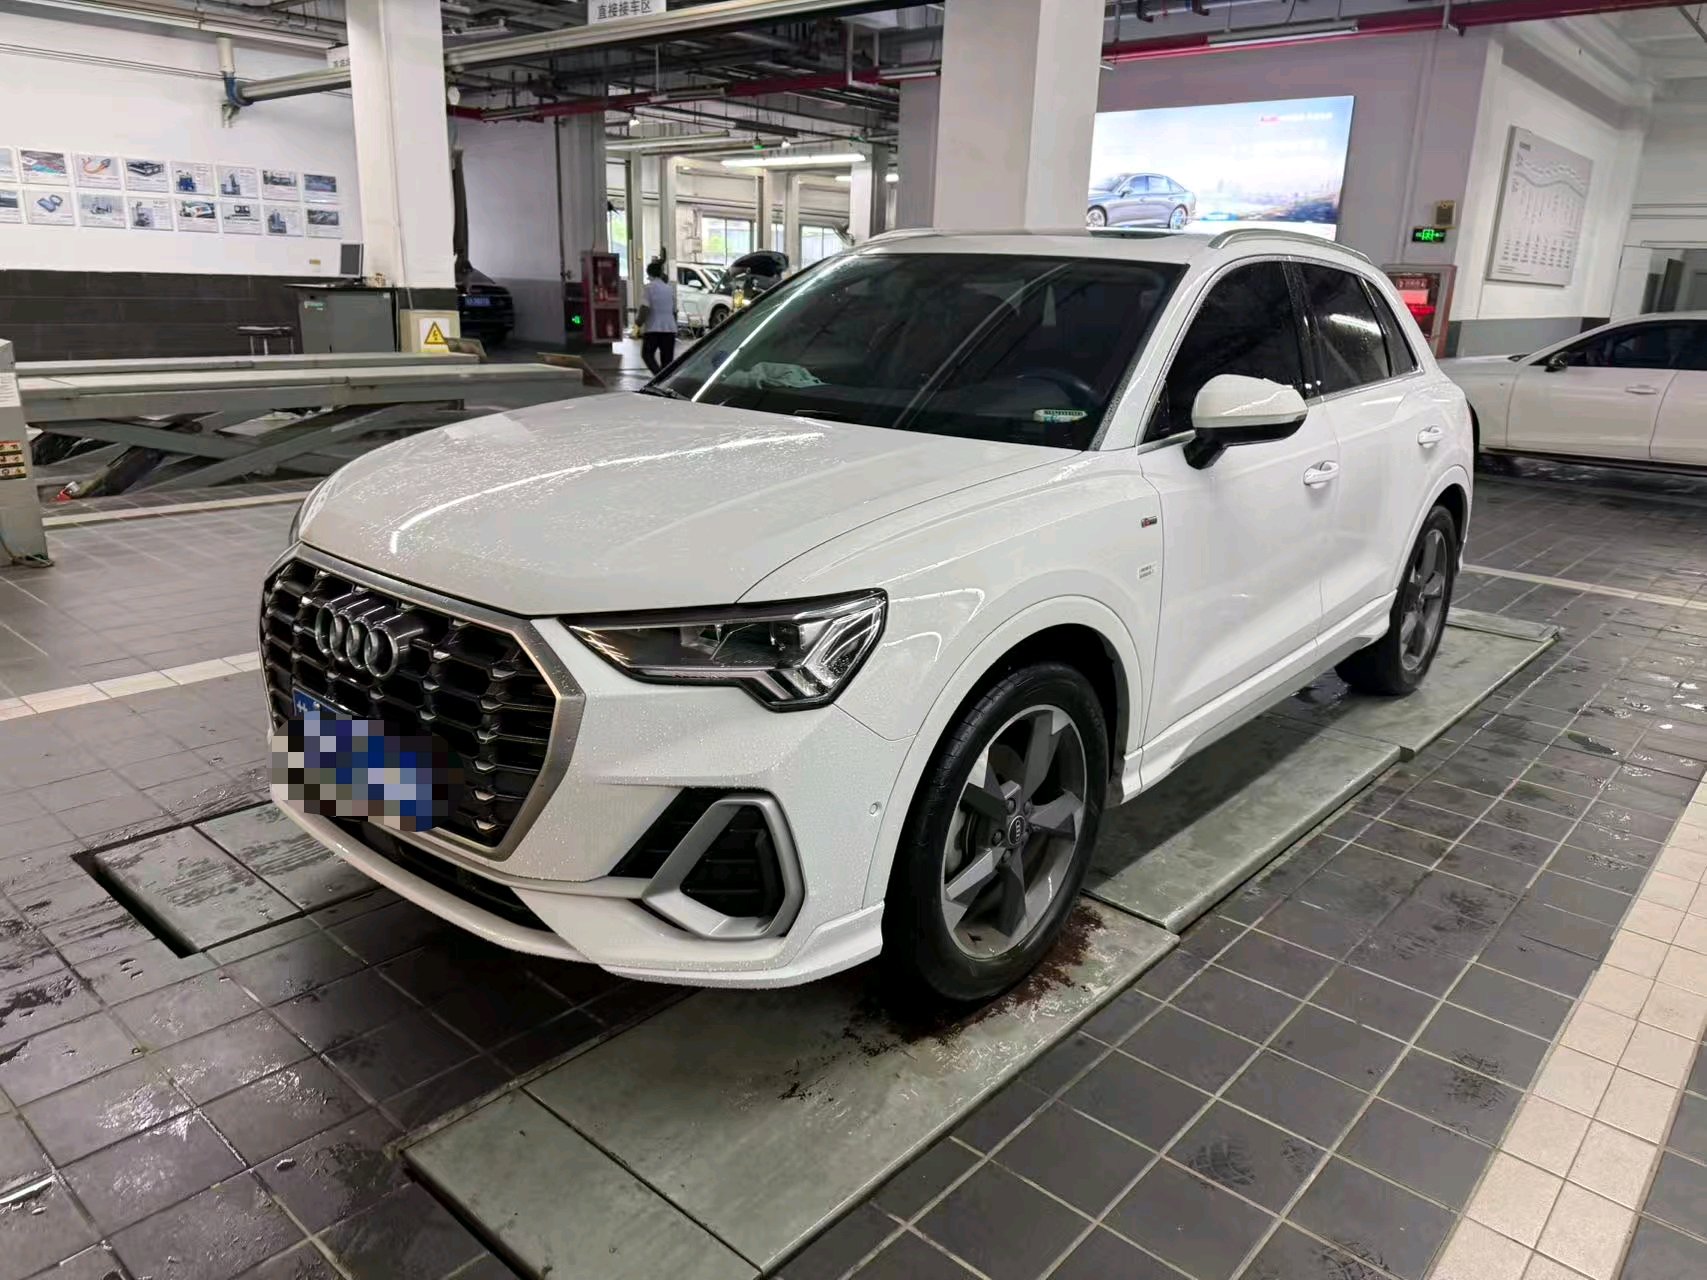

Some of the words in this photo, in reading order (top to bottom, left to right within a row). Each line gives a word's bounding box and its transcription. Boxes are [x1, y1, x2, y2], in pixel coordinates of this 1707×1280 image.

[598, 0, 652, 19] 直接接车区
